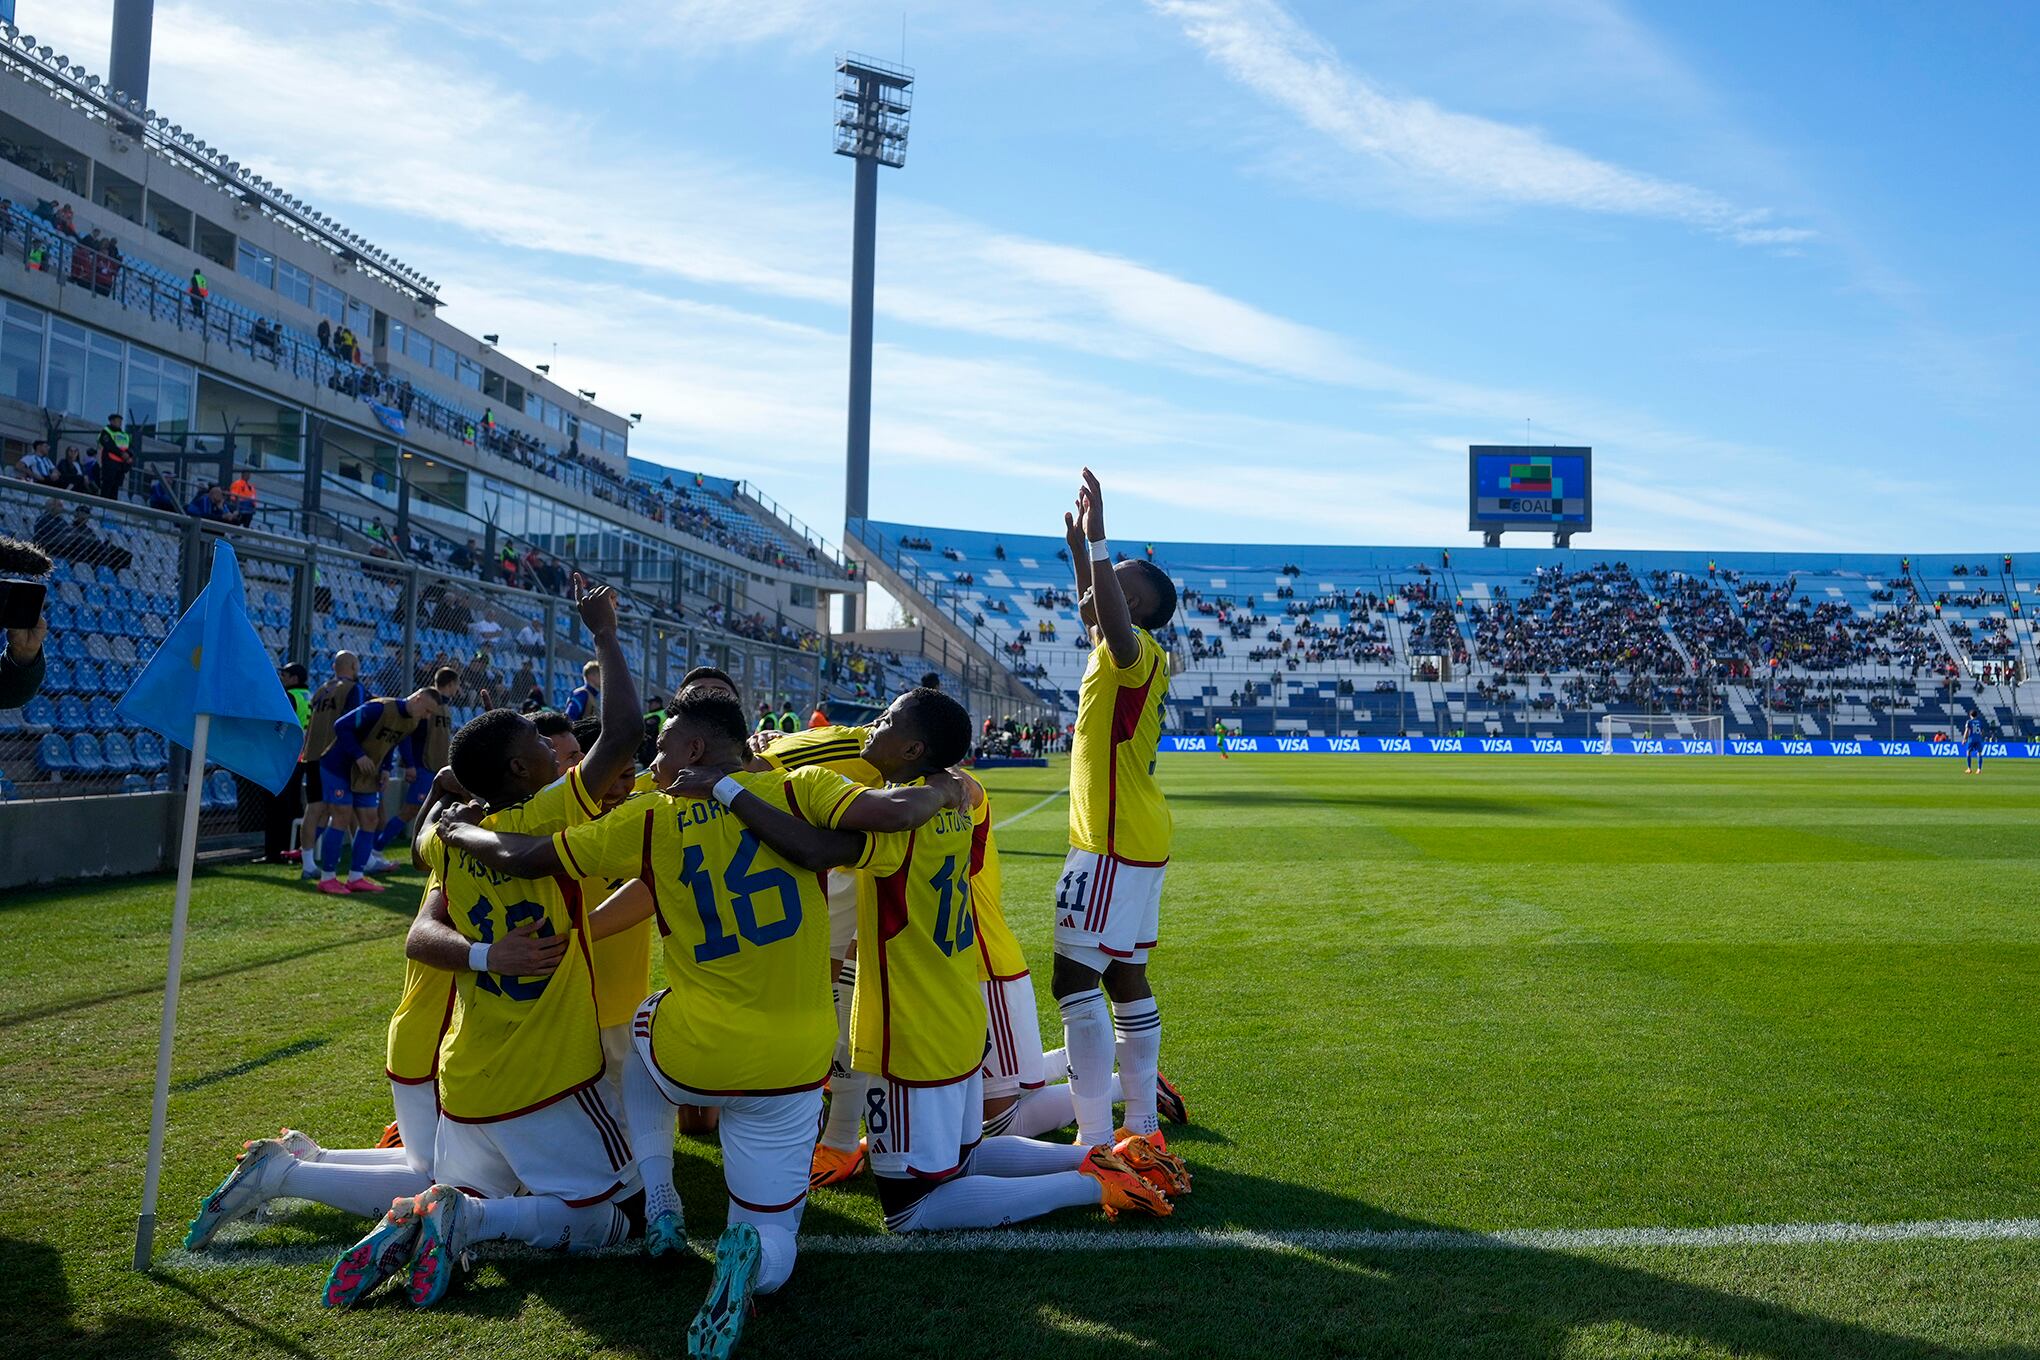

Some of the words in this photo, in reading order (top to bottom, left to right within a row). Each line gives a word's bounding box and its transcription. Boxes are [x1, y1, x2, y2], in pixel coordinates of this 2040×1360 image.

[1172, 738, 1206, 751] VISA
[1223, 738, 1257, 751] VISA
[1275, 738, 1309, 751] VISA
[1326, 738, 1360, 752] VISA
[1377, 739, 1411, 752] VISA
[1428, 739, 1462, 752] VISA
[1479, 739, 1513, 752] VISA
[1530, 739, 1563, 752] VISA
[1581, 740, 1612, 752] VISA
[1631, 740, 1663, 753] VISA
[1680, 740, 1713, 753] VISA
[1730, 741, 1763, 754] VISA
[1780, 741, 1813, 754] VISA
[1829, 742, 1862, 755] VISA
[1878, 742, 1911, 755] VISA
[1928, 743, 1960, 756] VISA
[2024, 744, 2040, 757] VI
[678, 827, 803, 964] 16
[1056, 870, 1088, 912] 11
